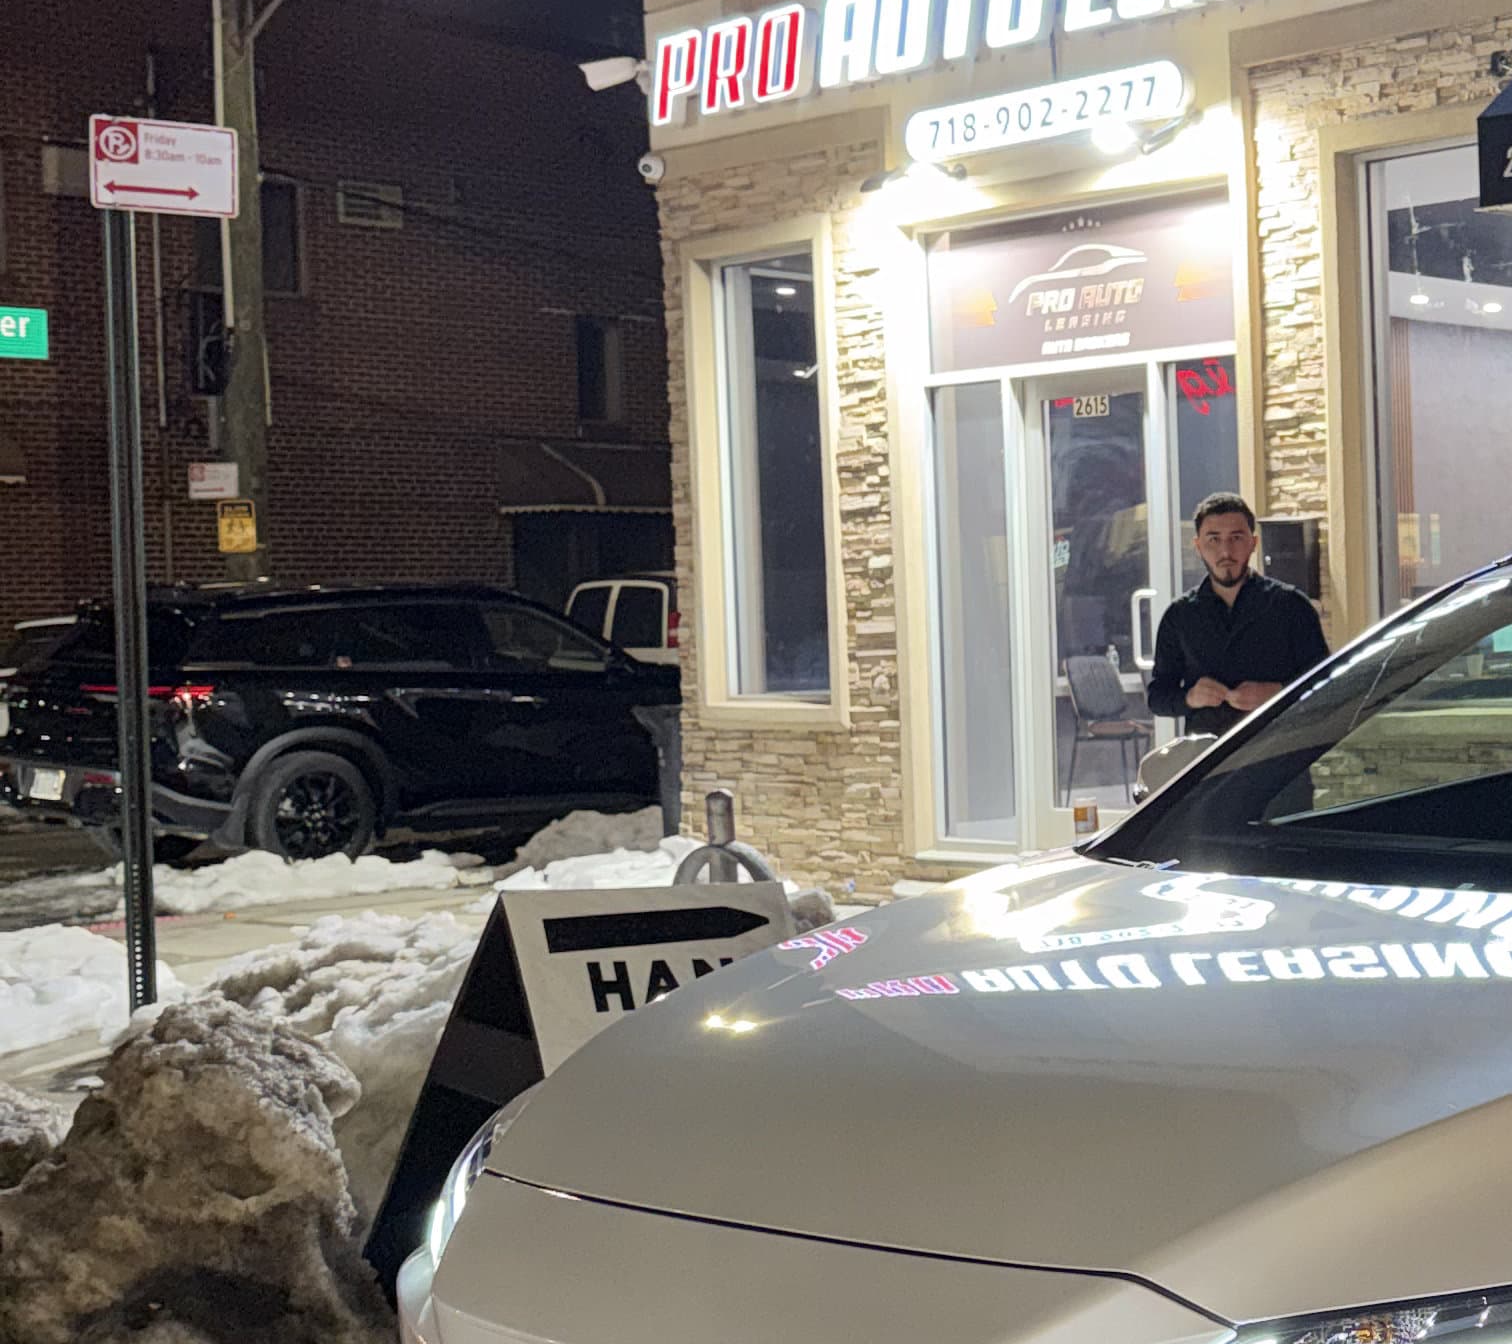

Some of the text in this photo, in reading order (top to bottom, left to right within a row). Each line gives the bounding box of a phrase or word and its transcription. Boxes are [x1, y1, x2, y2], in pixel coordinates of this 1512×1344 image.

[651, 2, 806, 126] PRO
[929, 77, 1156, 148] 718-902-2277
[143, 132, 177, 146] Friday
[1026, 278, 1145, 316] PRO AUTO
[1044, 309, 1127, 332] LEASING
[1074, 396, 1109, 416] 2615
